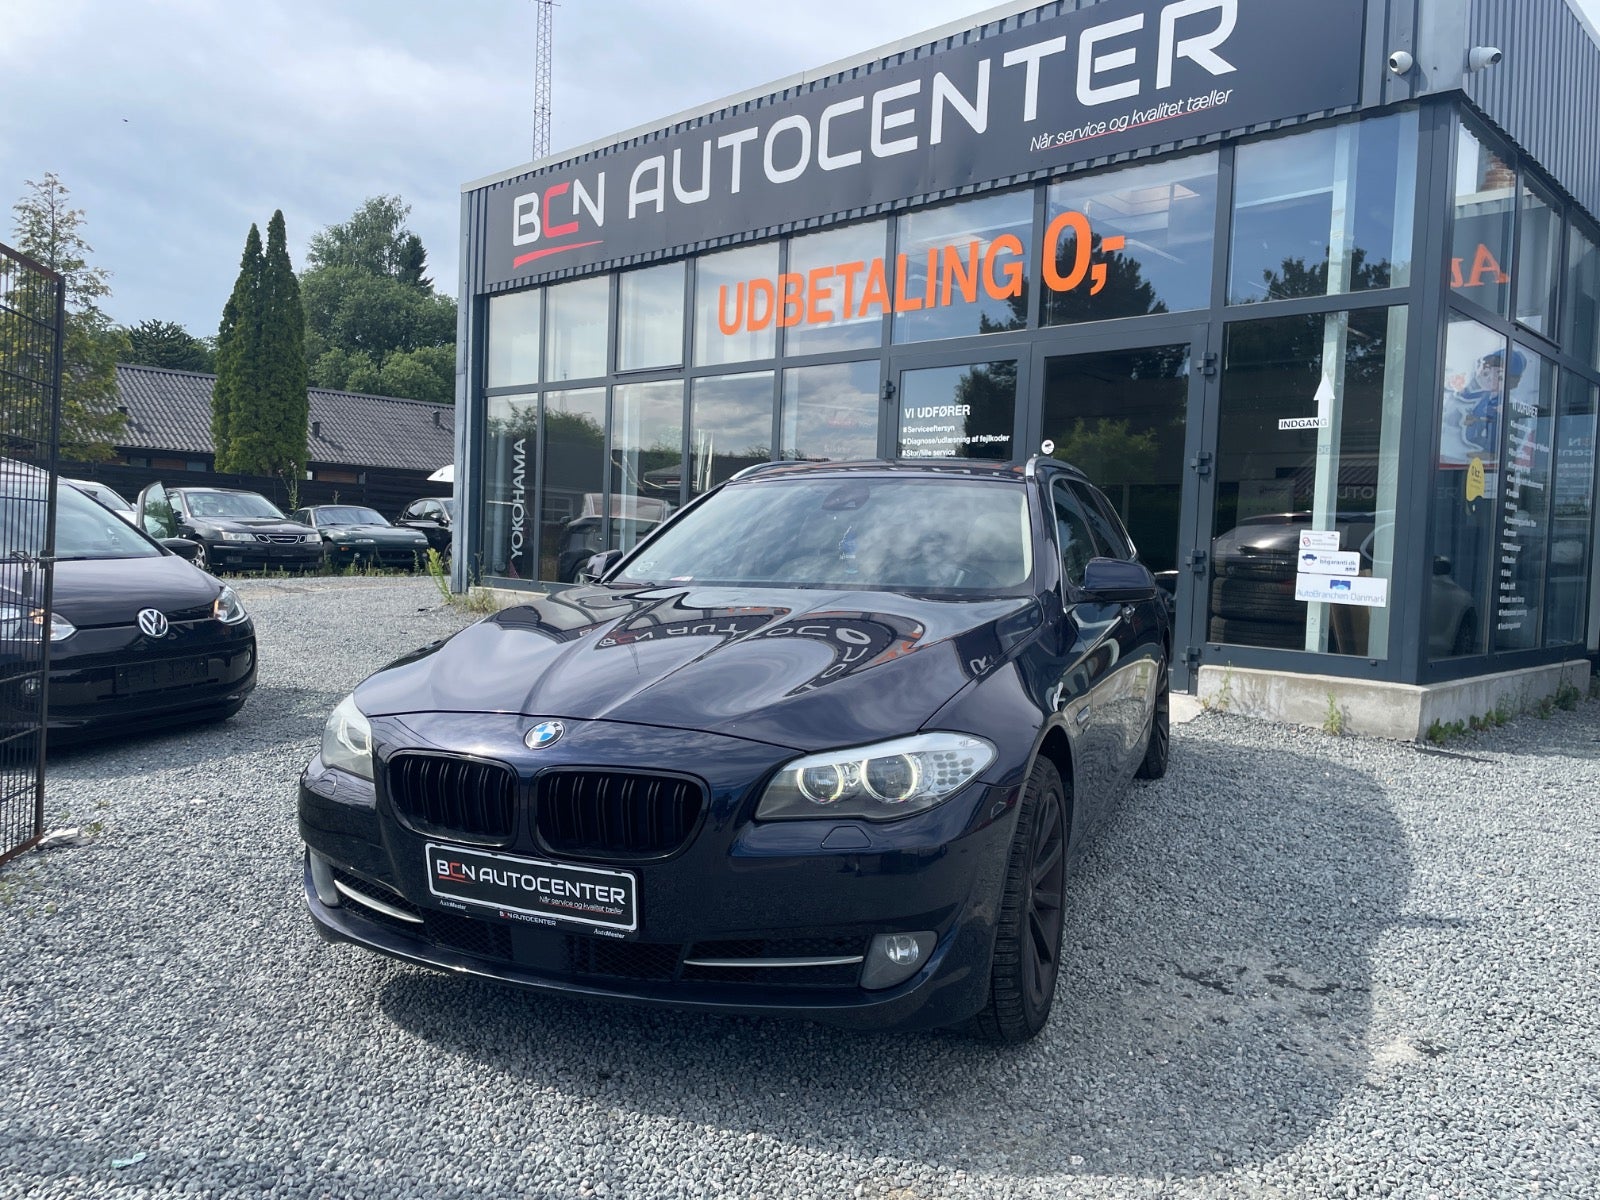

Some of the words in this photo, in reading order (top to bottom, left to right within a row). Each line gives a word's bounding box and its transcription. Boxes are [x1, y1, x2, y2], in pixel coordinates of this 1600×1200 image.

[513, 172, 605, 247] BCN
[628, 0, 1238, 220] AUTOCENTER
[1030, 132, 1056, 152] Når
[1056, 121, 1106, 145] service
[1109, 115, 1129, 132] og
[1131, 99, 1183, 124] kvalitet
[1187, 89, 1233, 112] tæller
[718, 234, 1025, 336] UDBETALING
[905, 408, 914, 419] VI
[917, 404, 971, 419] UDFØRER
[1280, 418, 1328, 429] INDGANG
[971, 435, 978, 443] af
[979, 434, 1010, 444] fejlkoder
[511, 438, 526, 560] YOKOHAMA
[1296, 589, 1349, 600] AutoBranchen
[1350, 592, 1385, 603] Danmark
[436, 859, 476, 881] BCN
[479, 867, 626, 905] AUTOCENTER
[551, 898, 573, 907] service
[583, 902, 605, 912] kvalitet
[513, 913, 556, 926] AUTOCENTER
